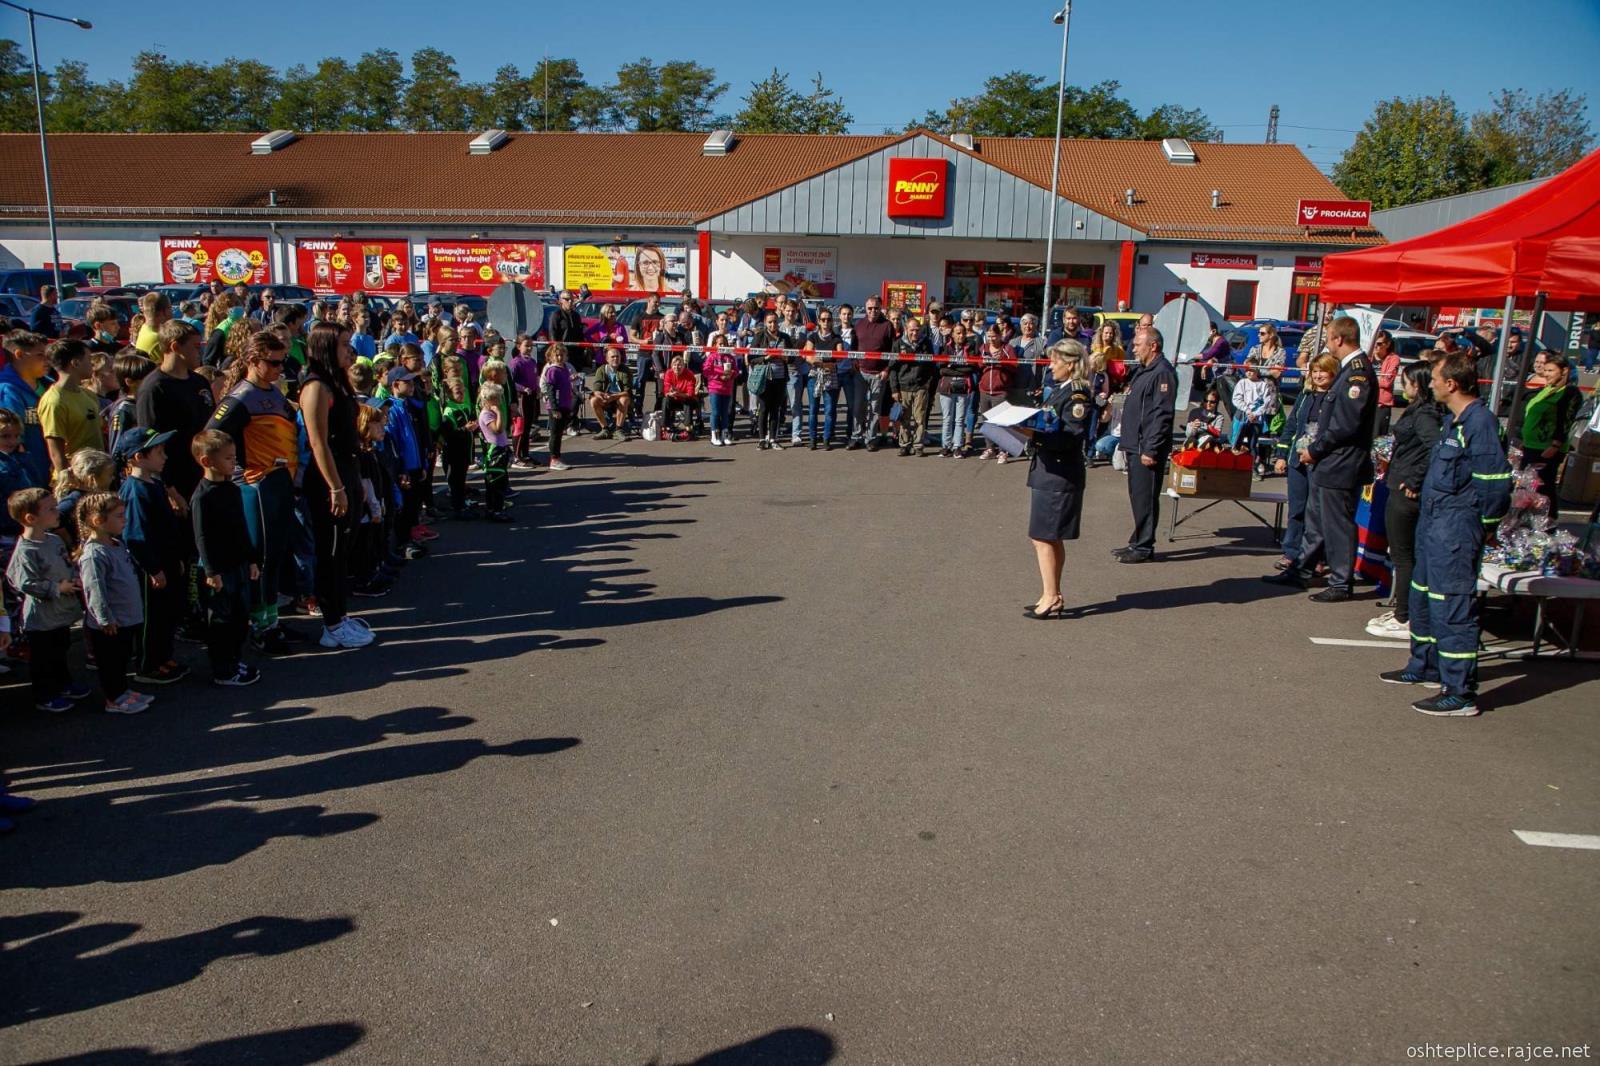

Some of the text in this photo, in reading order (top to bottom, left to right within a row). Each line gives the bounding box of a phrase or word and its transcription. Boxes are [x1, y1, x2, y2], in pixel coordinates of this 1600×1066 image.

[895, 180, 939, 193] PENNY
[1320, 209, 1367, 218] PROCHÁZKA
[1212, 255, 1253, 265] PROCHÁZKA
